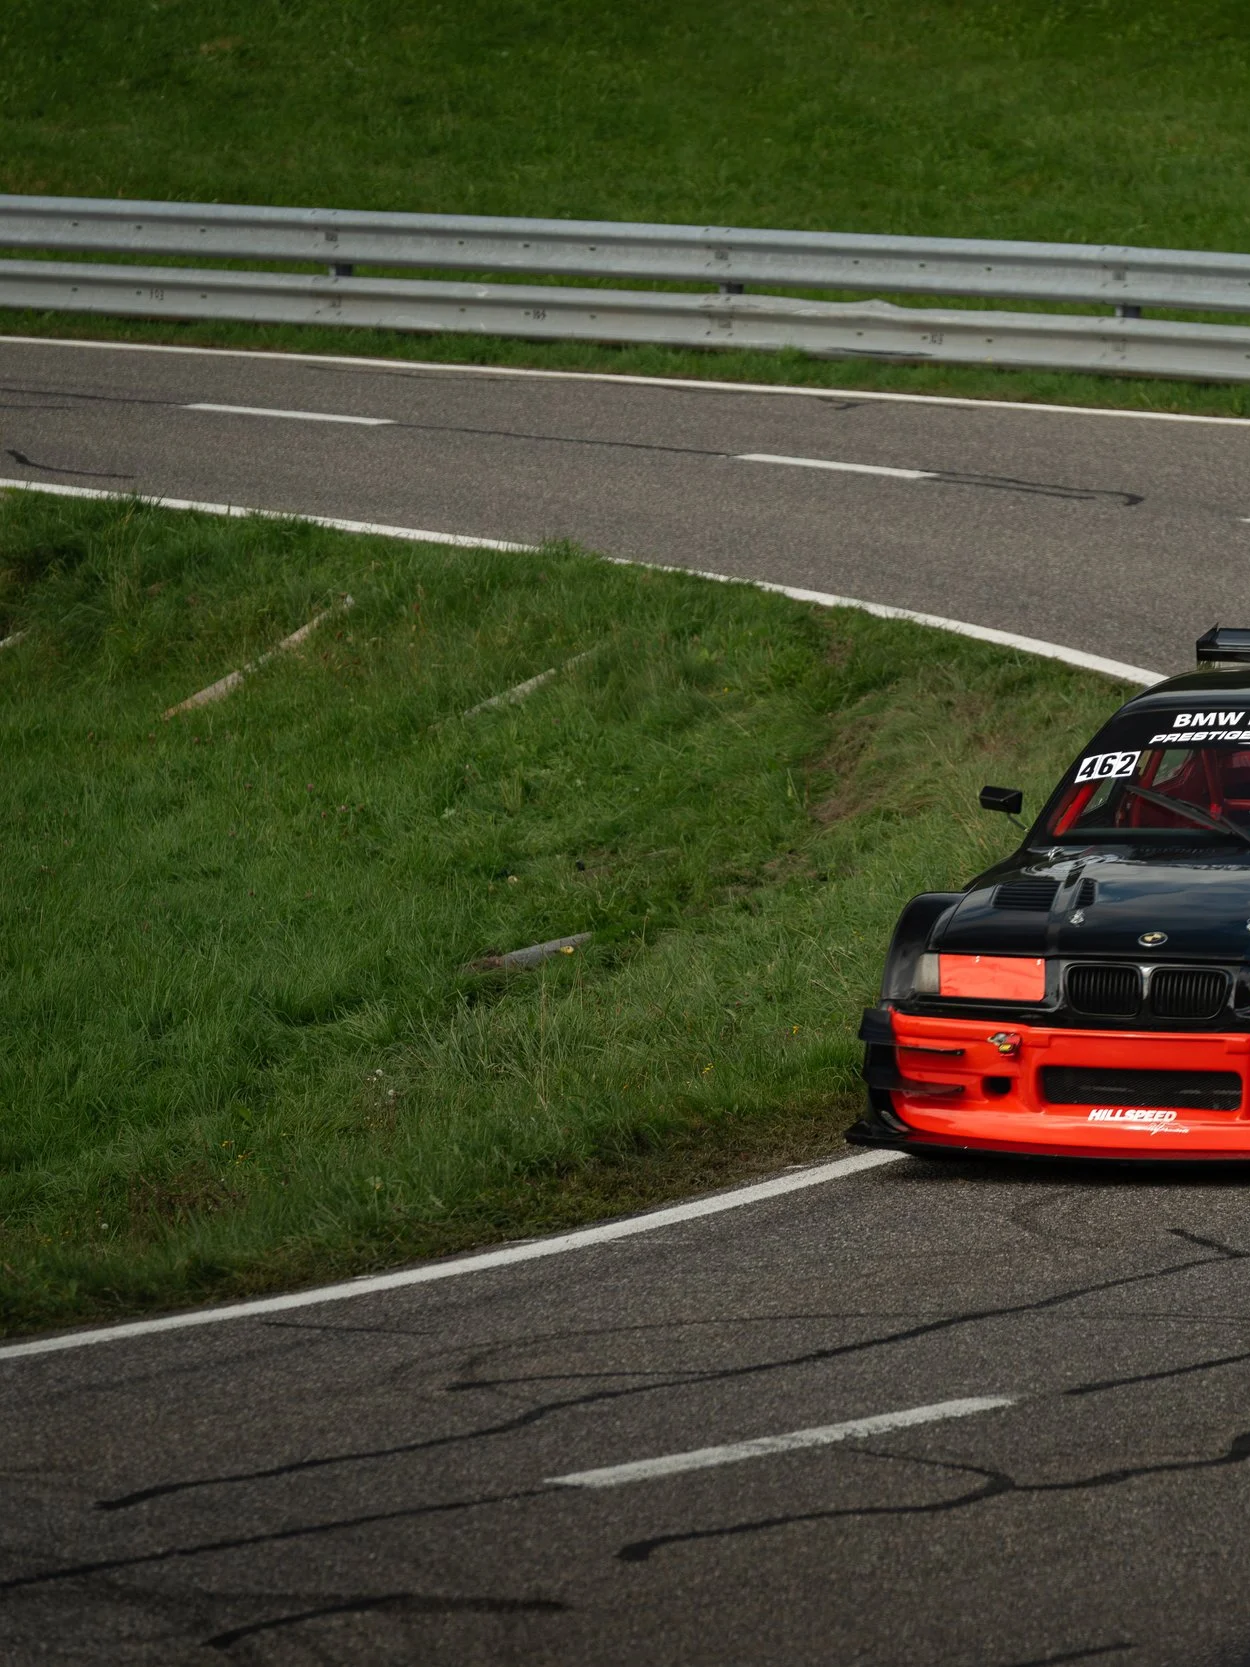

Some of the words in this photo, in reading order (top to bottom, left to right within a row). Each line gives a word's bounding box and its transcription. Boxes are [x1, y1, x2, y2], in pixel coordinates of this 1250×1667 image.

[1173, 711, 1245, 728] BMW
[1080, 752, 1138, 778] 462
[1087, 1109, 1177, 1123] HILLSPEED
